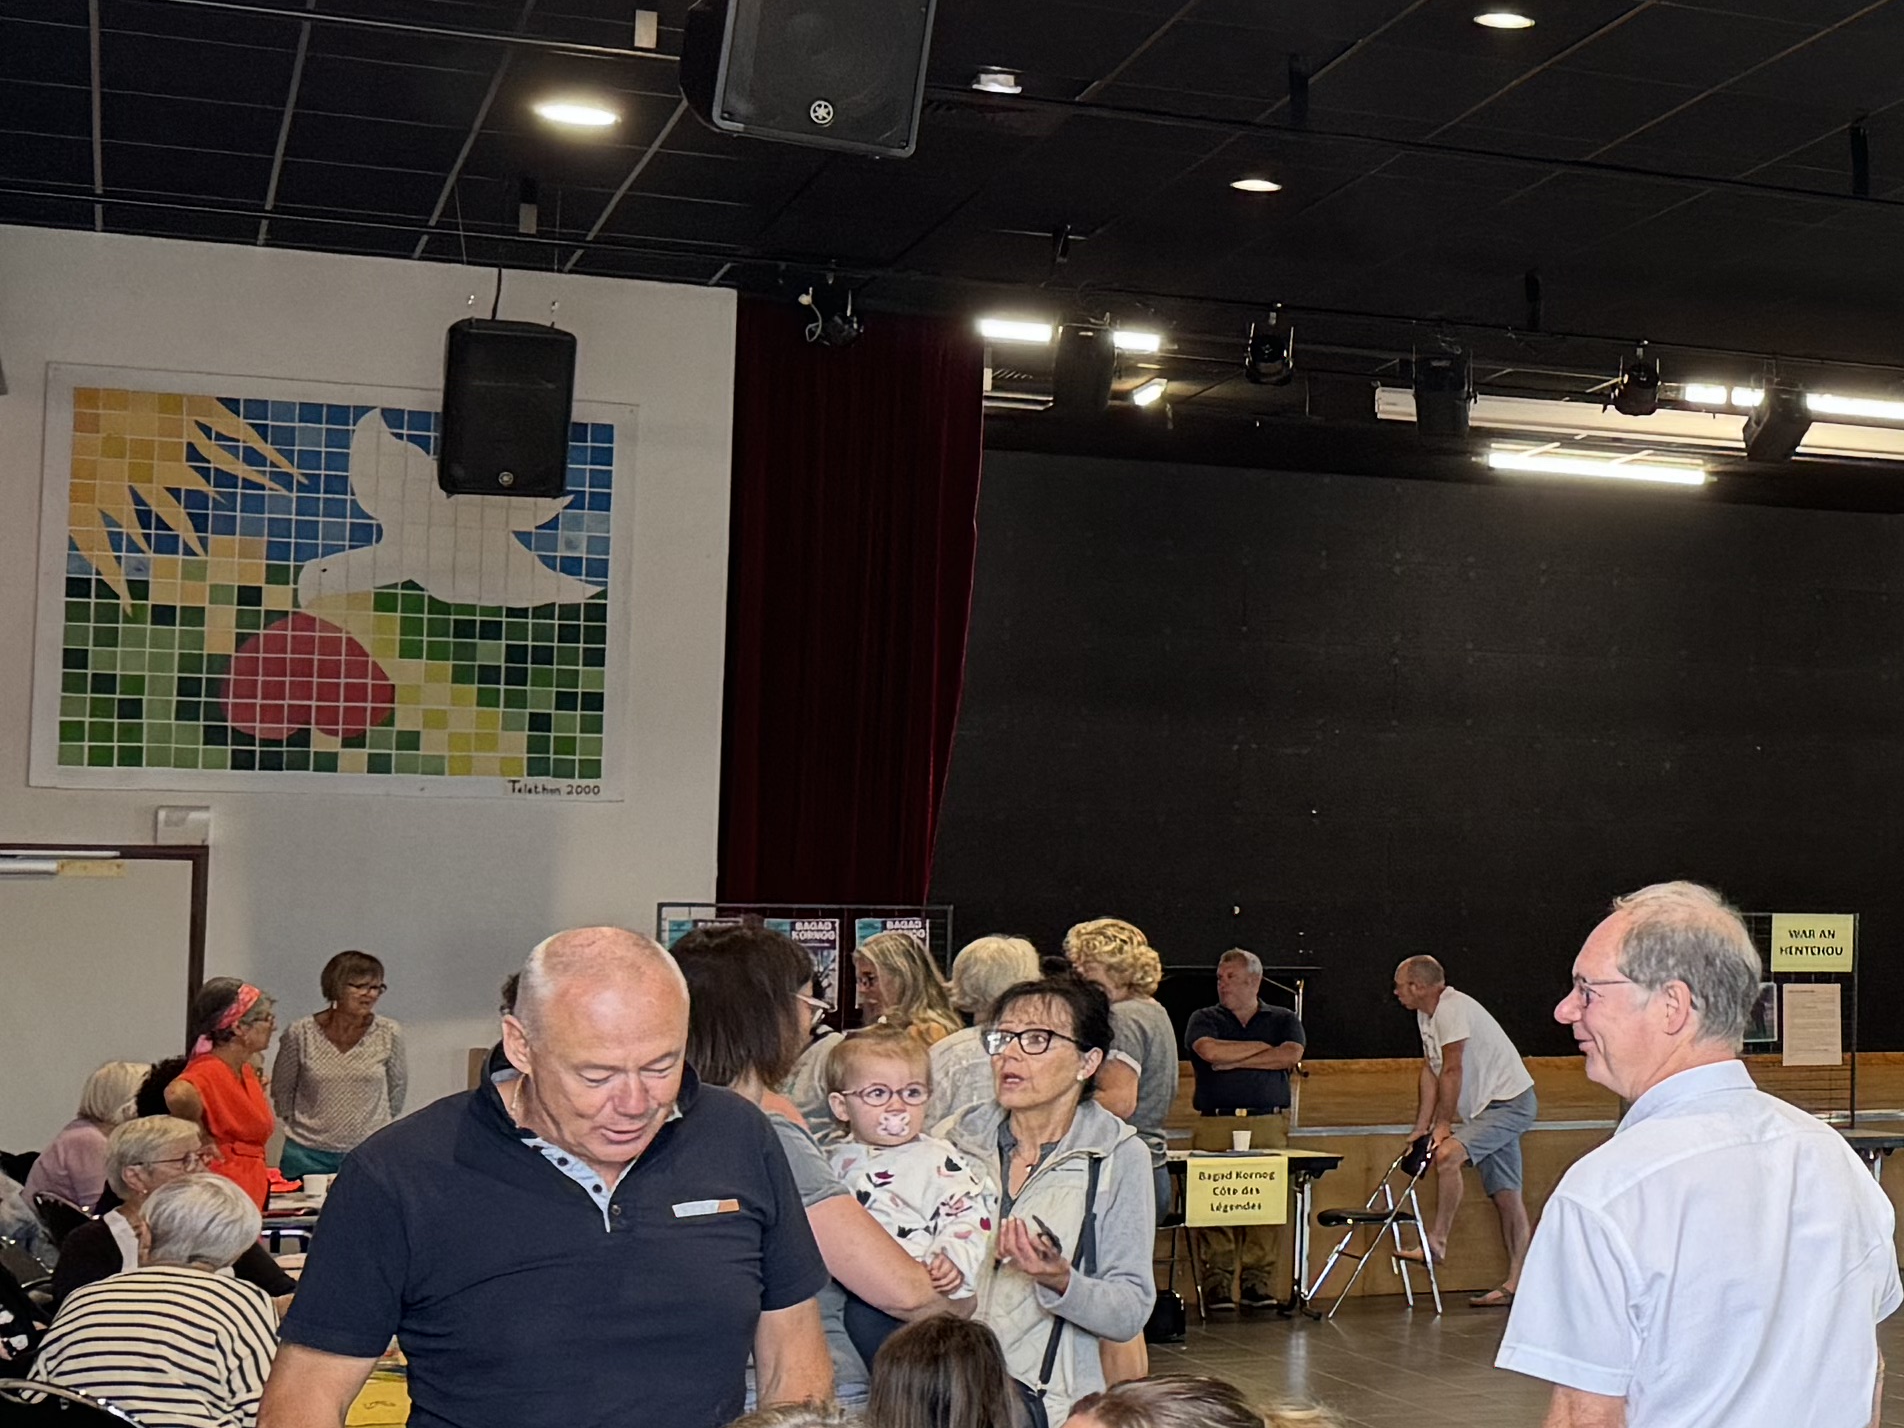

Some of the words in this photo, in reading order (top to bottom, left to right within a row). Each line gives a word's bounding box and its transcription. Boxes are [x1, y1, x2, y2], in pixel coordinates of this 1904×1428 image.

[566, 784, 601, 796] 2000
[794, 921, 833, 931] BAGAD
[791, 931, 836, 941] KORNOG
[1788, 929, 1815, 940] WAR
[1819, 929, 1836, 940] AN
[1198, 1171, 1232, 1182] Bagad
[1235, 1171, 1276, 1181] Kornog
